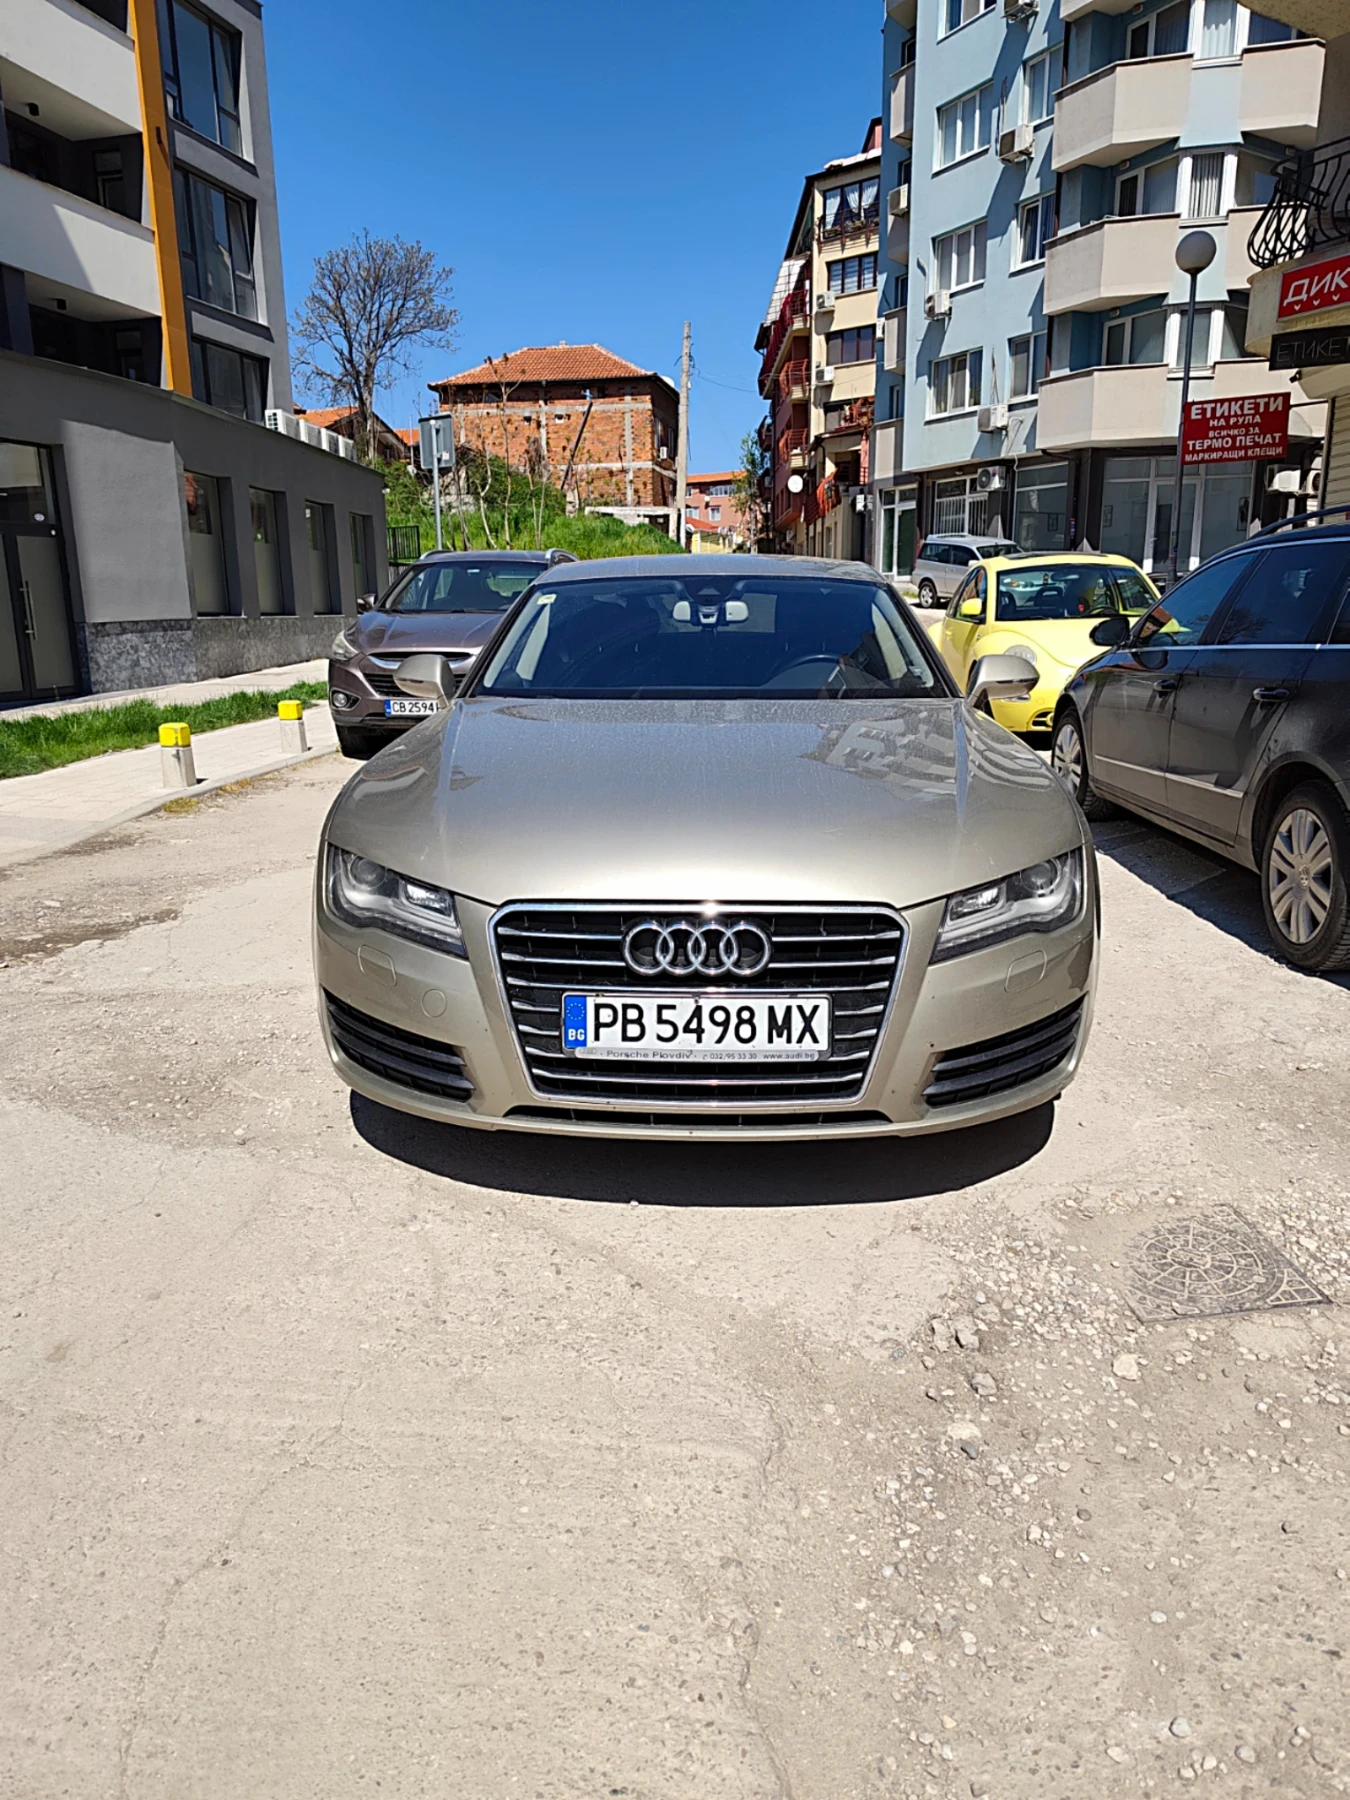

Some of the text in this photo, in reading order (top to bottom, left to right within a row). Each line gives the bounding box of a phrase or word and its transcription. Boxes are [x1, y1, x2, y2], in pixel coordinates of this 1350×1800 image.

[1190, 396, 1283, 420] ЕТИКЕТИ
[1209, 415, 1261, 427] НА РУЛА
[1208, 426, 1260, 438] ВСИЧКО ЗА
[1187, 433, 1282, 451] ТЕРМО ПЕЧАТ
[1184, 446, 1283, 462] МАРКИРАЩИ КЛЕЩИ
[408, 702, 434, 713] 2594
[594, 1003, 820, 1044] PB 5498 MX
[568, 1029, 585, 1041] BG
[606, 1049, 649, 1059] Porsche
[652, 1049, 692, 1059] Plovdiv
[763, 1052, 815, 1061] www.audi.bg
